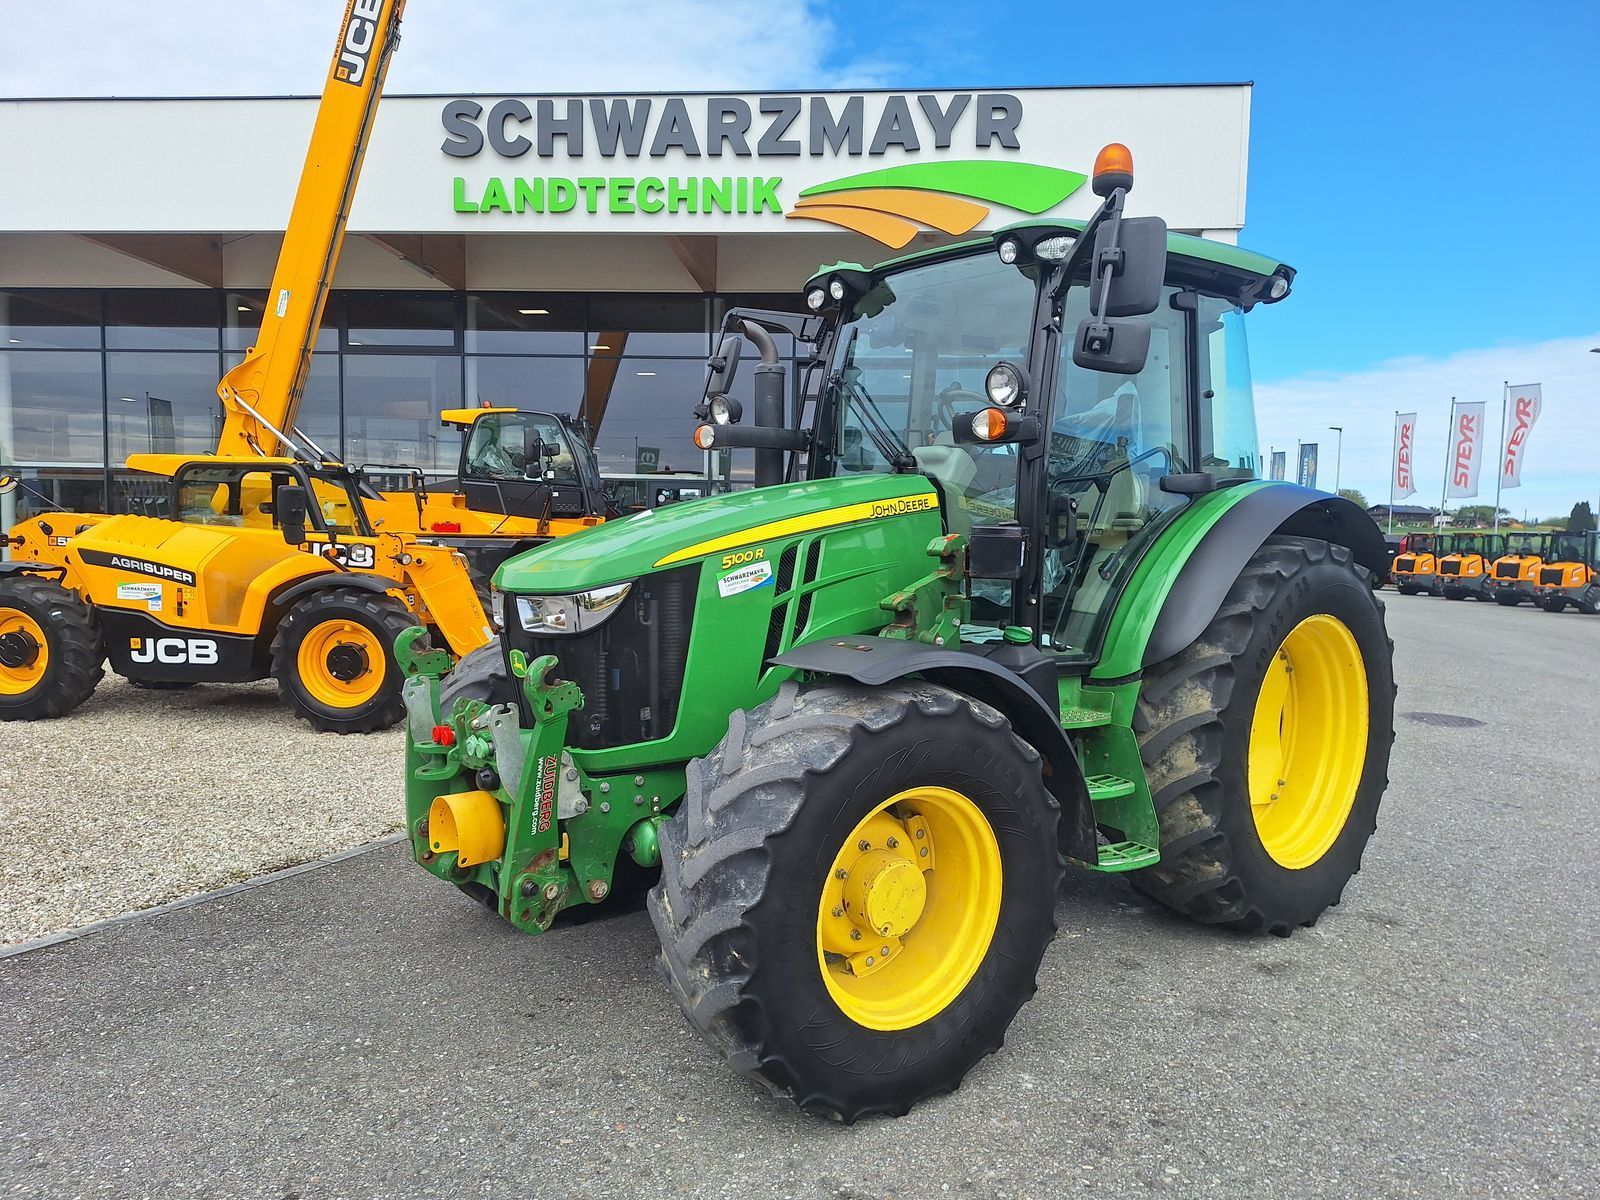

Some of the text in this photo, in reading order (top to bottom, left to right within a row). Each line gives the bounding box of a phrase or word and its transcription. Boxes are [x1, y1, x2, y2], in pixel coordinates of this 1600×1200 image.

[441, 93, 1024, 158] SCHWARZMAYR
[453, 175, 784, 214] LANDTECHNIK
[1397, 423, 1411, 490] STEYR
[1453, 414, 1475, 489] STEYR
[1504, 397, 1532, 478] STEYR
[870, 498, 930, 517] JOHN DEERE
[111, 556, 193, 584] AGRISUPER
[721, 549, 755, 570] 5100
[755, 547, 765, 560] R
[723, 567, 764, 583] SCHWARZMAYR
[130, 637, 219, 665] JCB
[530, 756, 544, 836] www.zuidberg.com
[538, 753, 558, 833] ZUIDBERG
